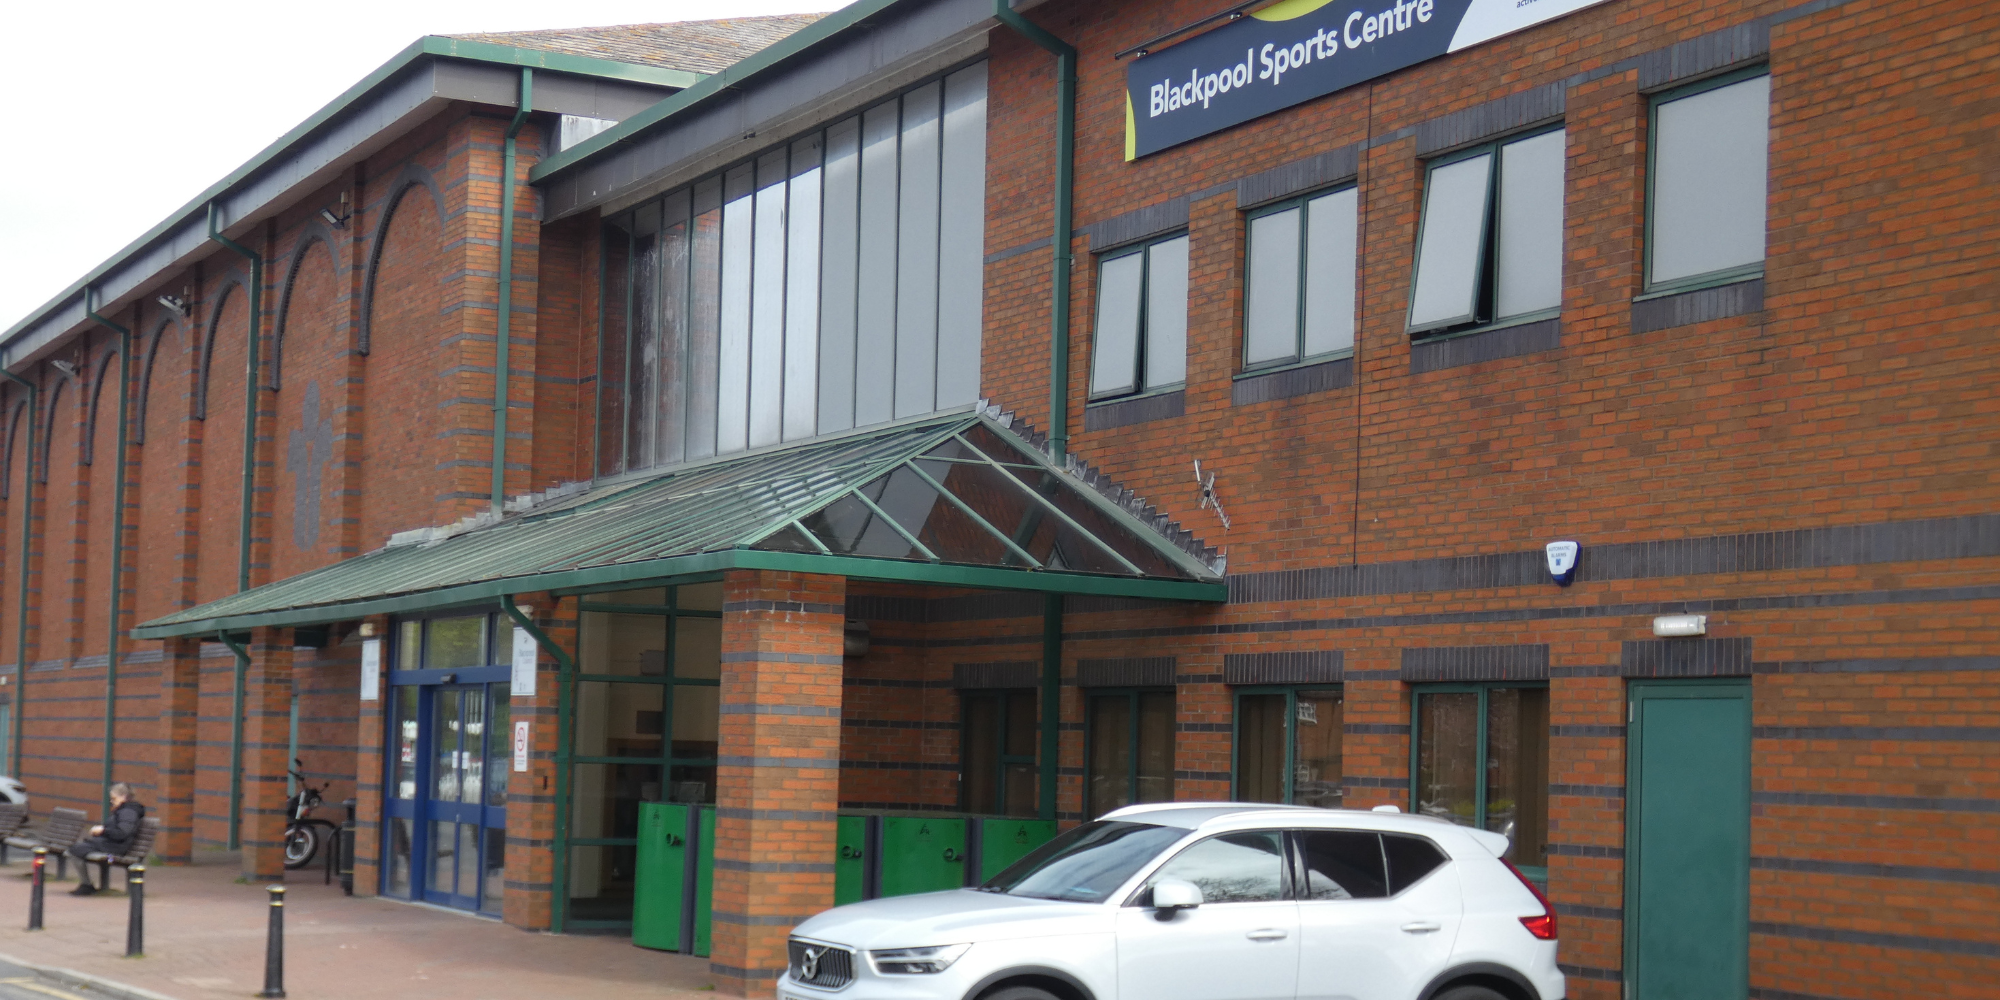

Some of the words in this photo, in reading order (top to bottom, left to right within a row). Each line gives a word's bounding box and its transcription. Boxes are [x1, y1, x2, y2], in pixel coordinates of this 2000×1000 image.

[1150, 48, 1254, 118] Blackpool
[1259, 28, 1338, 86] Sports
[1343, 0, 1434, 49] Centre
